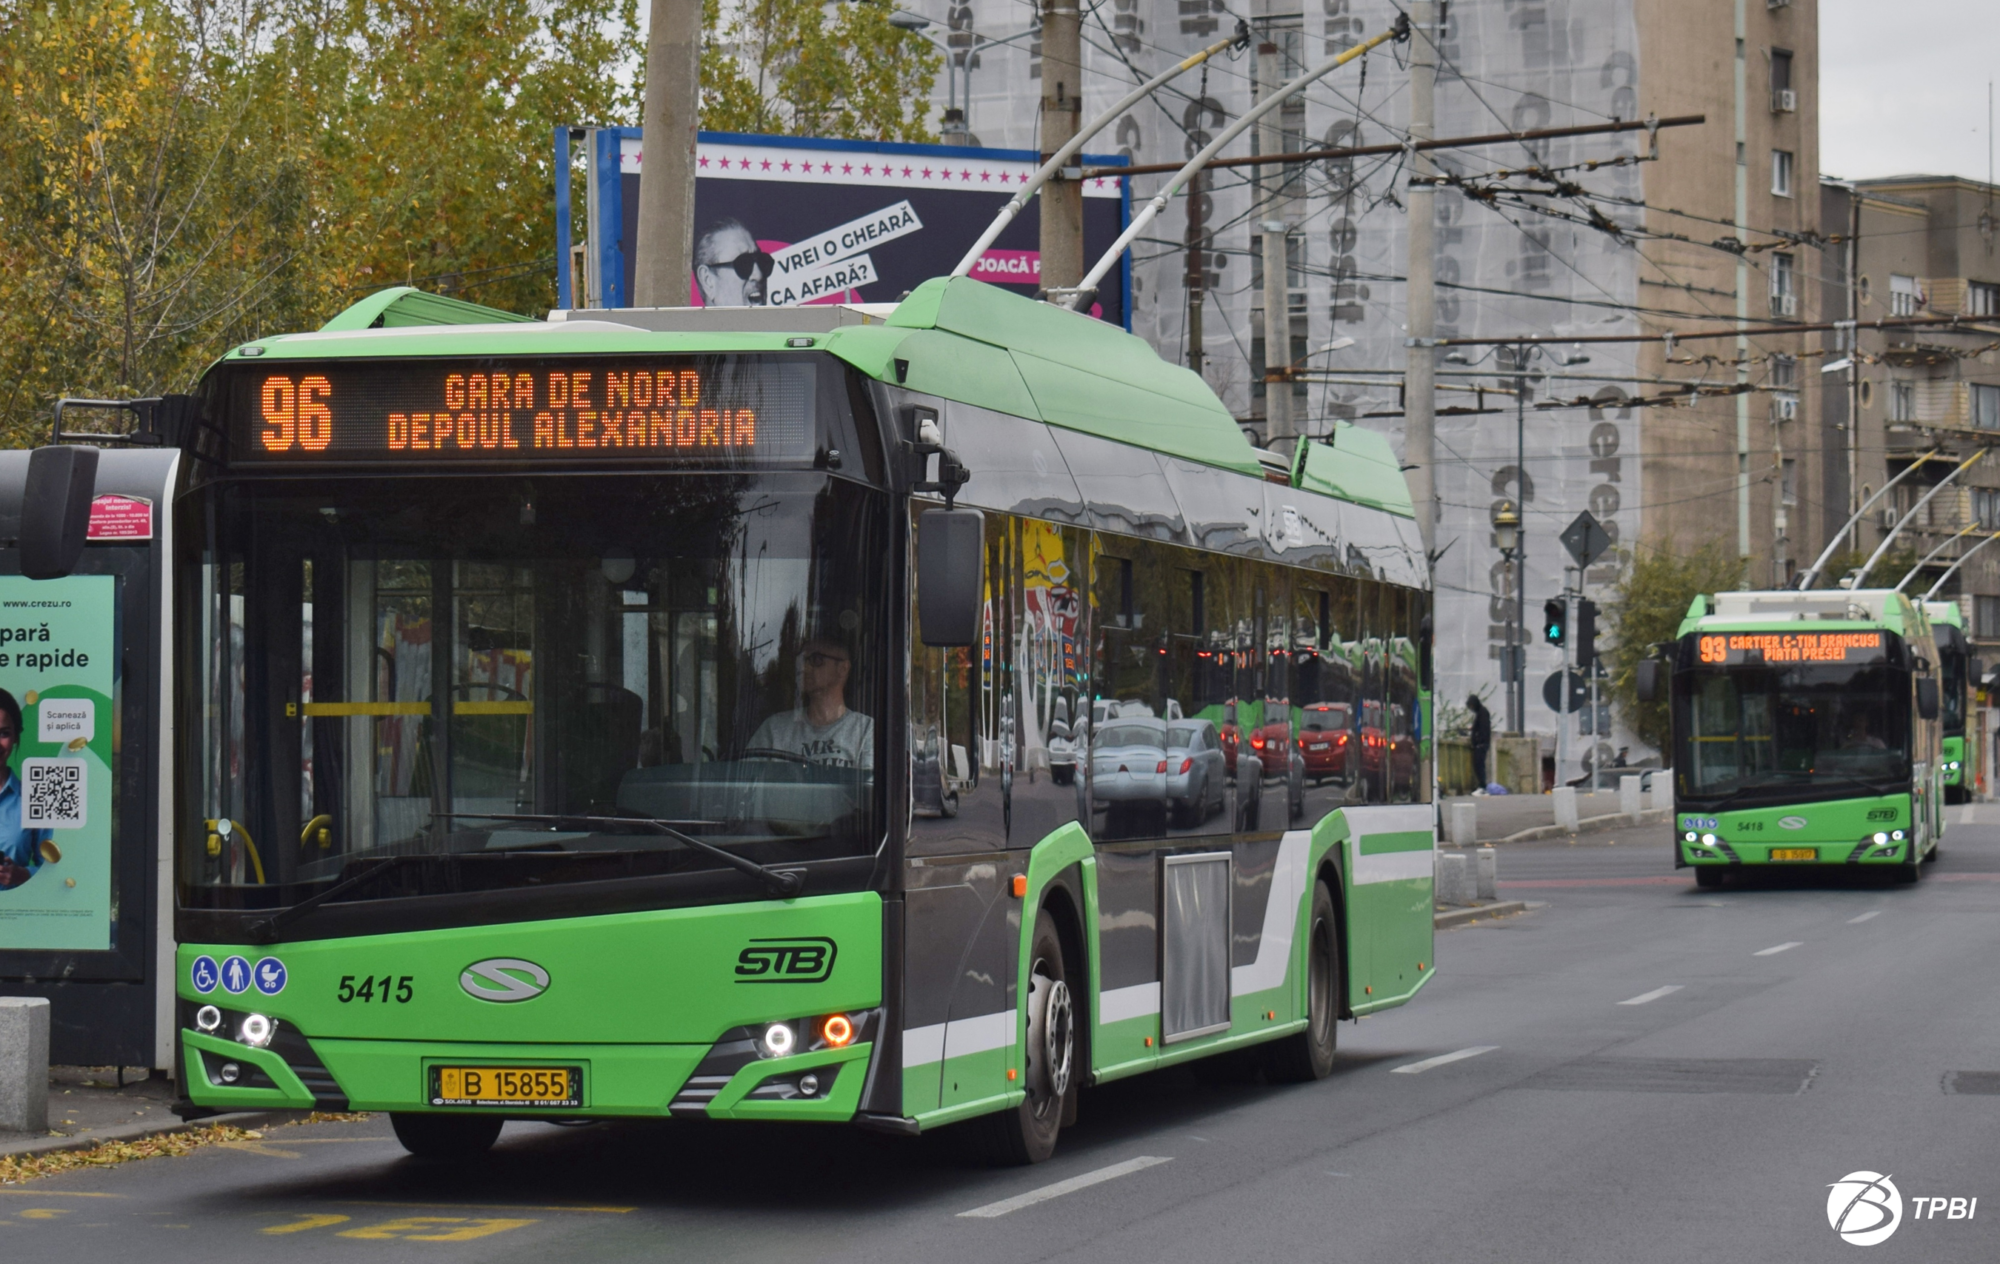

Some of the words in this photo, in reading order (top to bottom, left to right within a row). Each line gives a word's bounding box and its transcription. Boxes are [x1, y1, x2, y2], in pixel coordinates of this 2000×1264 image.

[777, 246, 821, 274] VREI
[824, 240, 837, 256] O
[841, 206, 915, 250] GHEARĂ
[977, 256, 1030, 274] JOACĂ
[770, 284, 797, 307] CA
[800, 263, 869, 299] AFARĂ?
[445, 373, 534, 410] GARA
[549, 372, 592, 408] DE
[607, 371, 700, 407] NORD
[261, 376, 332, 451] 96
[388, 412, 519, 450] DEPOUL
[534, 409, 756, 449] ALEXANDRIA
[3, 600, 72, 608] www.crezu.ro
[1701, 636, 1727, 662] 93
[1729, 636, 1780, 649] CARTIER
[1820, 633, 1880, 648] BRANCUSI
[16, 648, 89, 673] rapide
[1763, 648, 1799, 661] PIATA
[1802, 647, 1845, 660] PRESEI
[47, 710, 87, 719] Scanează
[47, 722, 54, 731] și
[55, 721, 81, 732] aplică
[1737, 822, 1763, 831] 5418
[1866, 809, 1896, 820] STB
[735, 944, 829, 977] STB
[337, 975, 414, 1004] 5415
[464, 1072, 482, 1096] B
[495, 1072, 565, 1097] 15855
